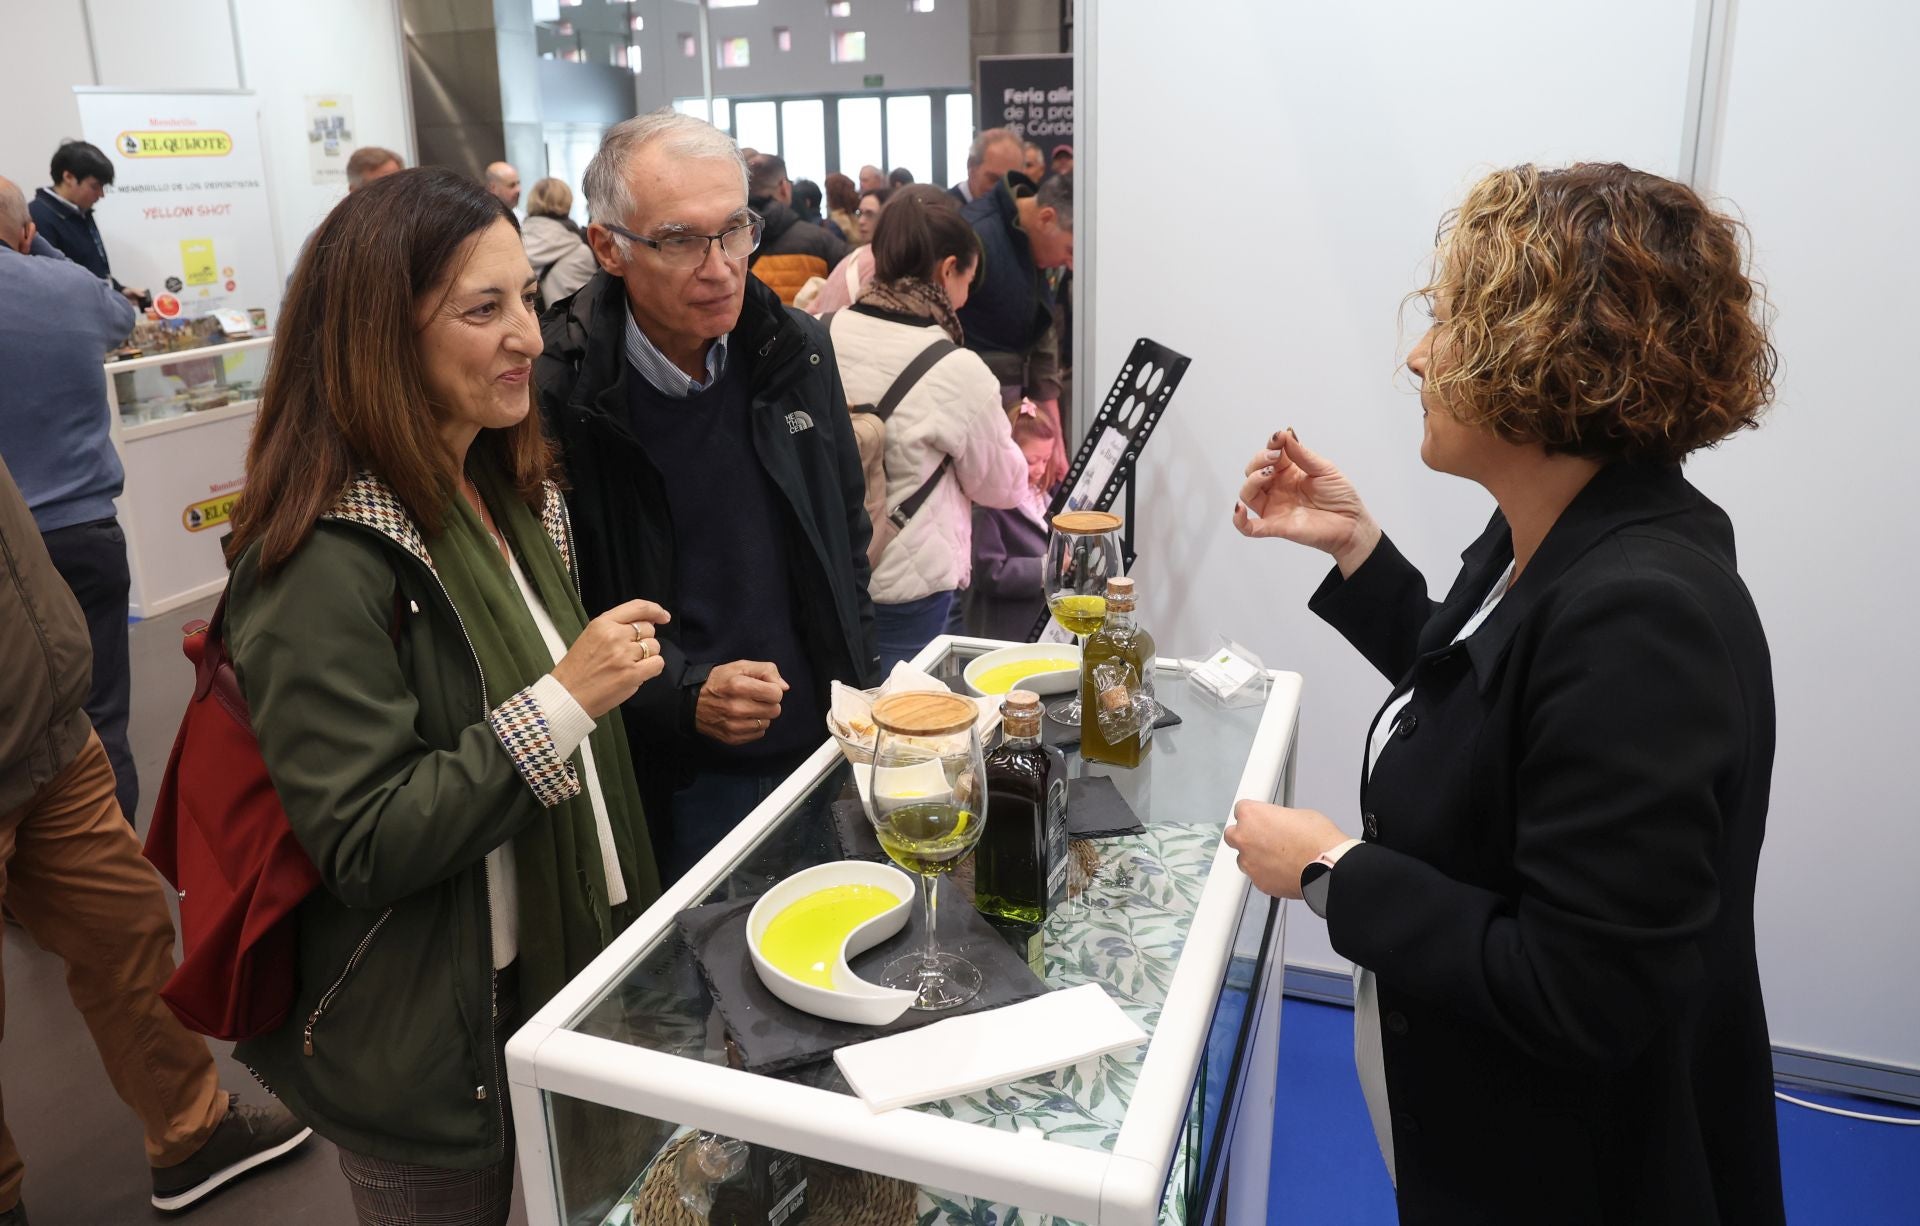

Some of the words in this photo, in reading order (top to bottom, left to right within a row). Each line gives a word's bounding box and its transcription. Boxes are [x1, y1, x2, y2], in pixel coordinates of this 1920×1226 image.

[1004, 87, 1045, 105] Feria
[1004, 105, 1025, 120] de
[1028, 104, 1044, 120] la
[143, 206, 193, 219] YELLOW
[197, 203, 232, 217] SHOT
